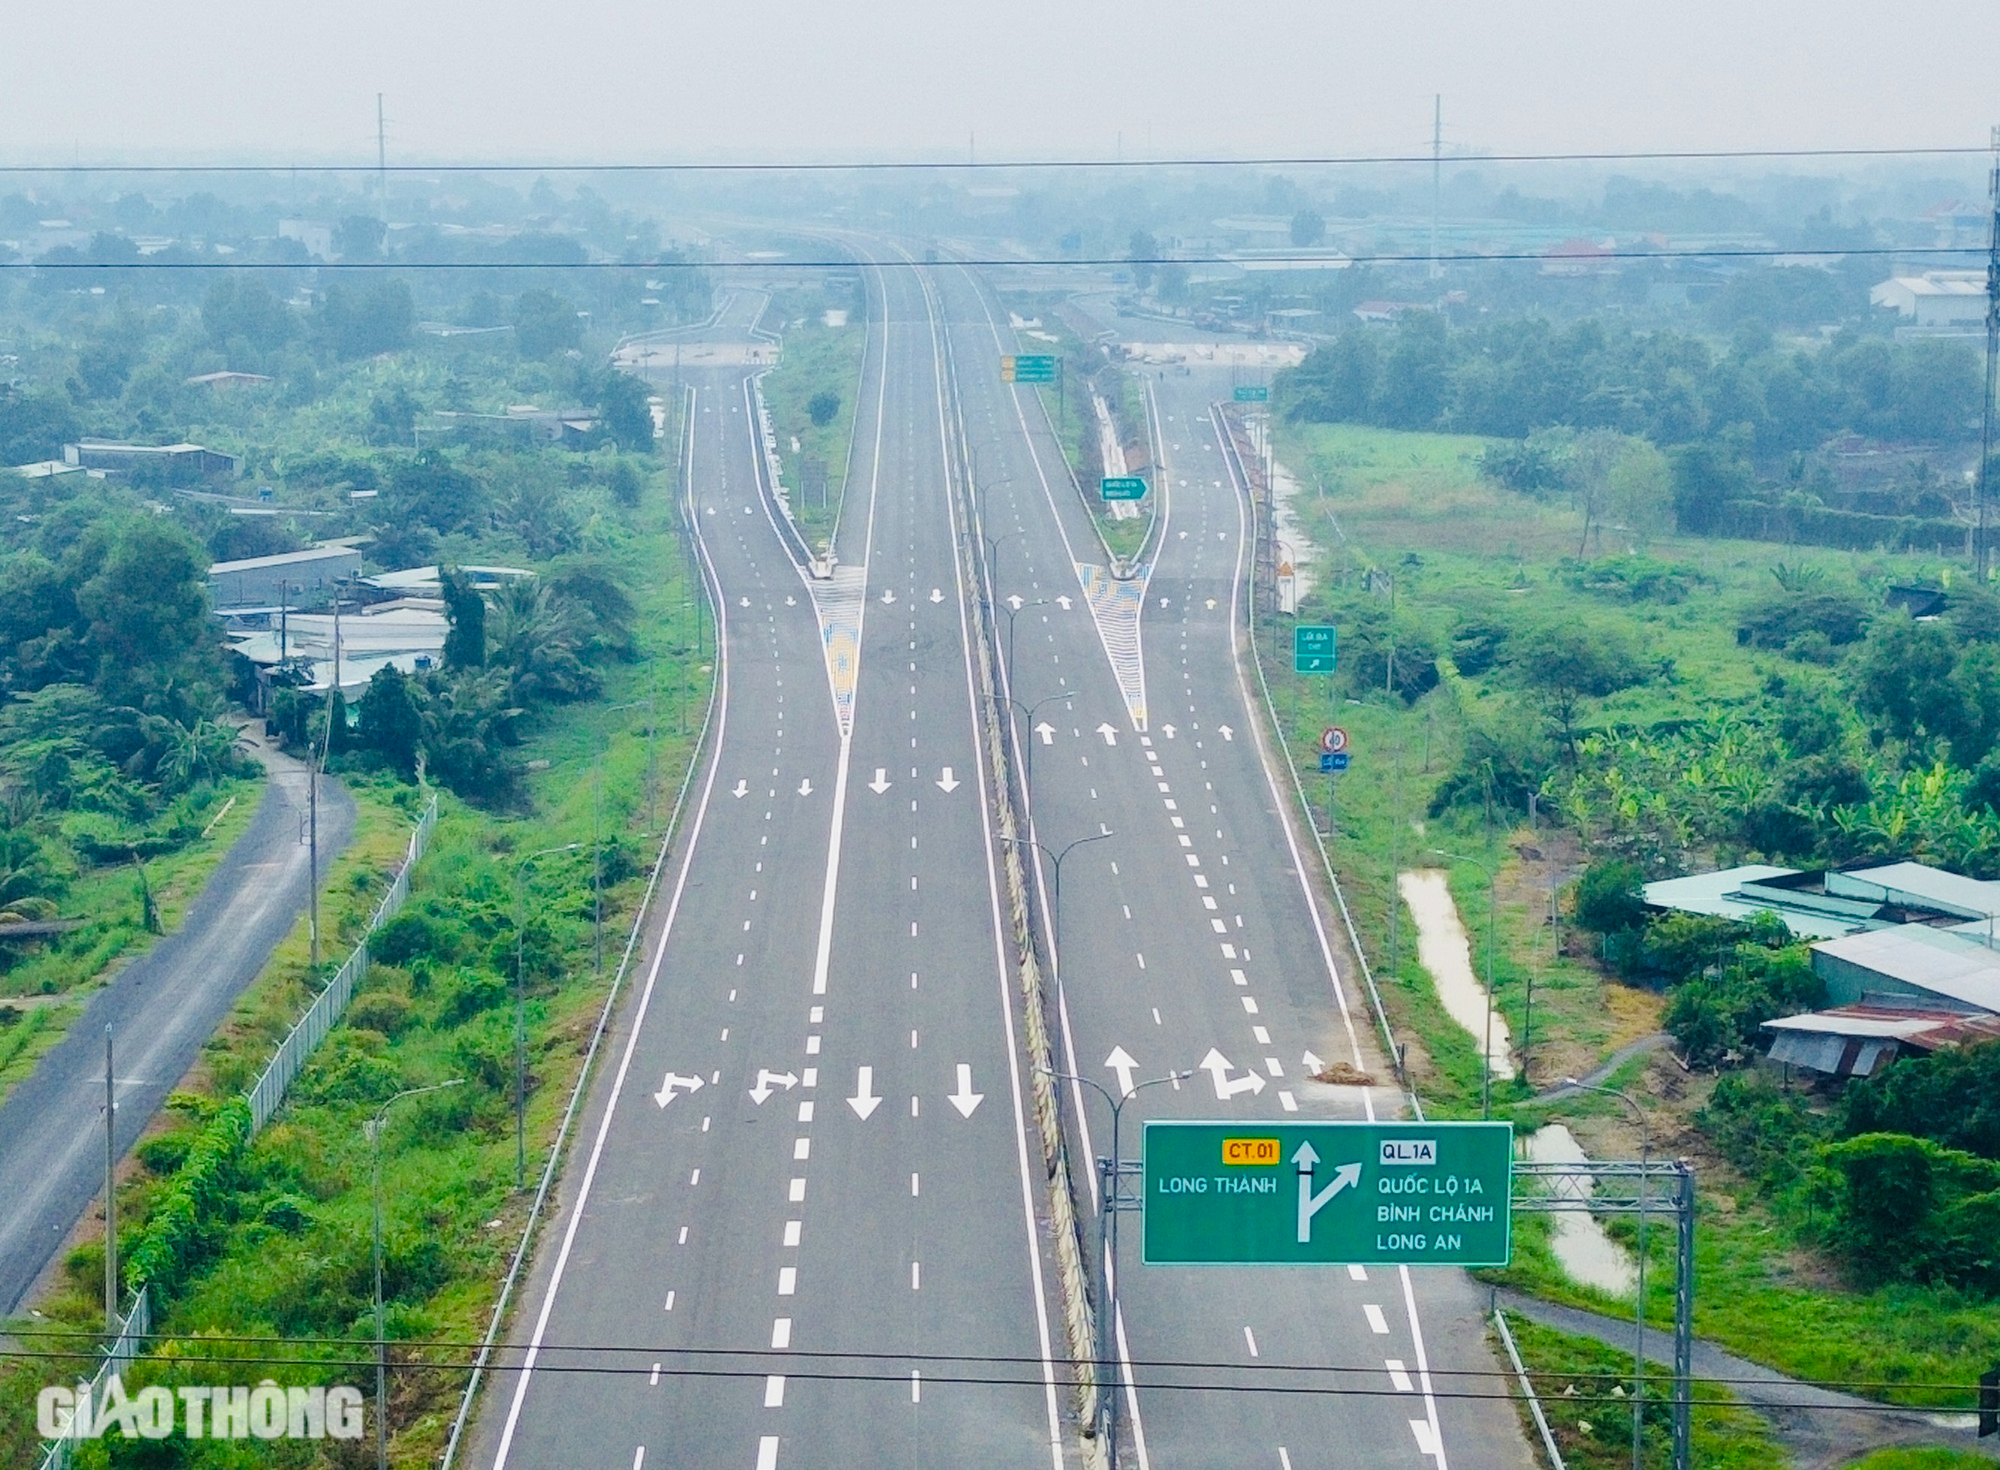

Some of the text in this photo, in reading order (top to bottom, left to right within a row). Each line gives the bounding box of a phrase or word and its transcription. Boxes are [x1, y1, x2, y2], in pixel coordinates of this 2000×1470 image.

[1229, 1143, 1273, 1158] CT.01
[1159, 1174, 1277, 1193] LONG THÀNH
[1378, 1172, 1483, 1197] QUỐC LỘ 1A
[1377, 1202, 1494, 1222] BÌNH CHÁNH
[1376, 1234, 1462, 1250] LONG AN
